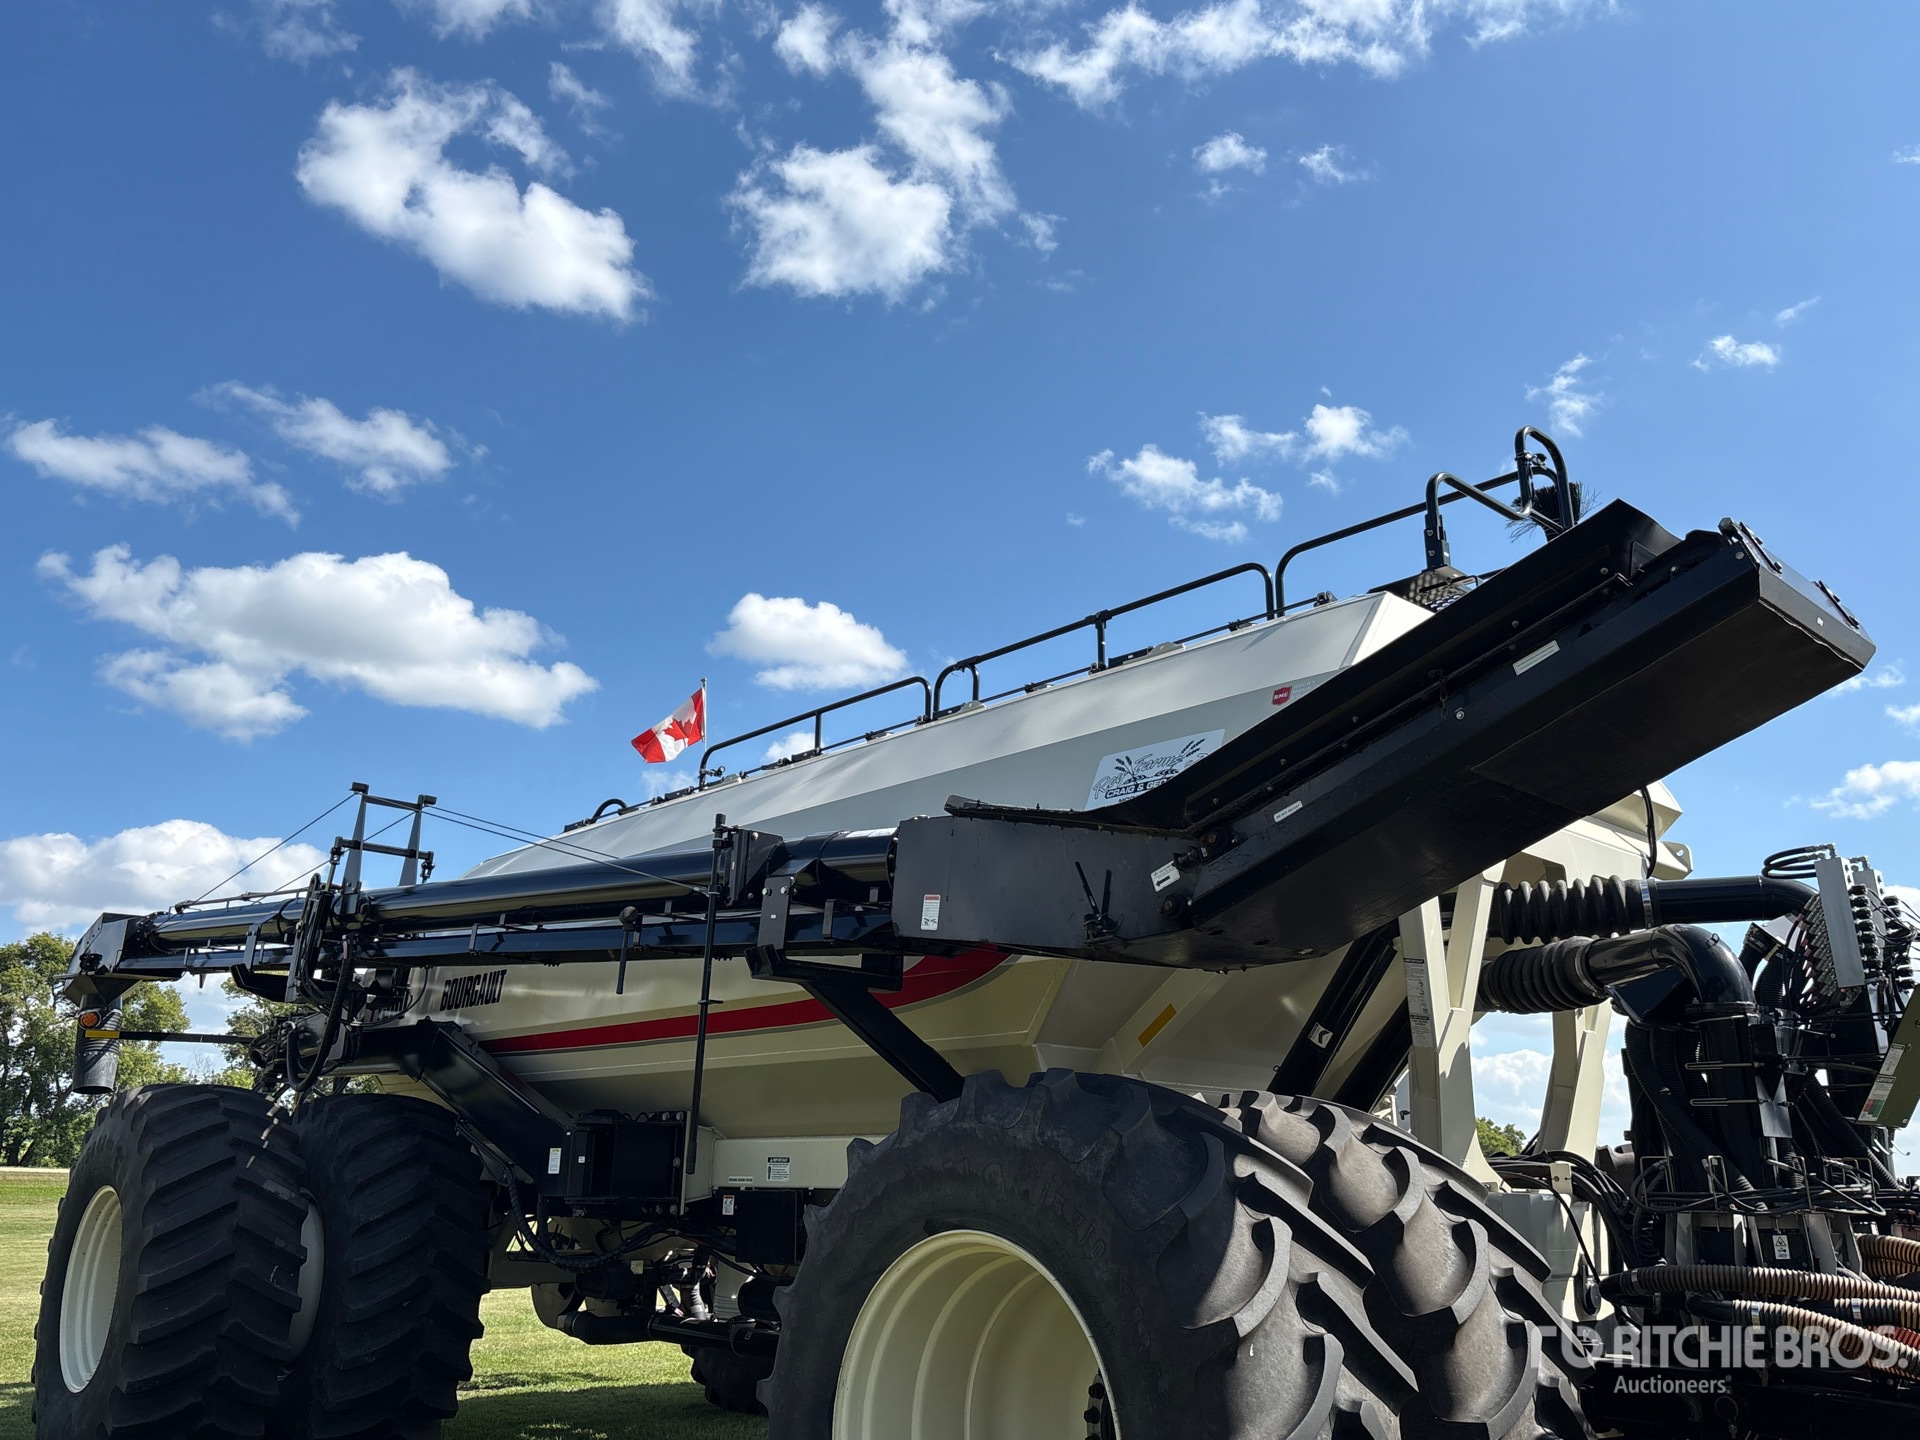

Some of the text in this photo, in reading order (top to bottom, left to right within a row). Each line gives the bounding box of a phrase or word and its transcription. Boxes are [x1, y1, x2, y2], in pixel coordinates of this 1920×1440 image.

[1274, 692, 1289, 700] RME
[1106, 785, 1136, 798] CRAIG
[1137, 783, 1145, 792] &
[440, 968, 507, 1011] BOURGAULT
